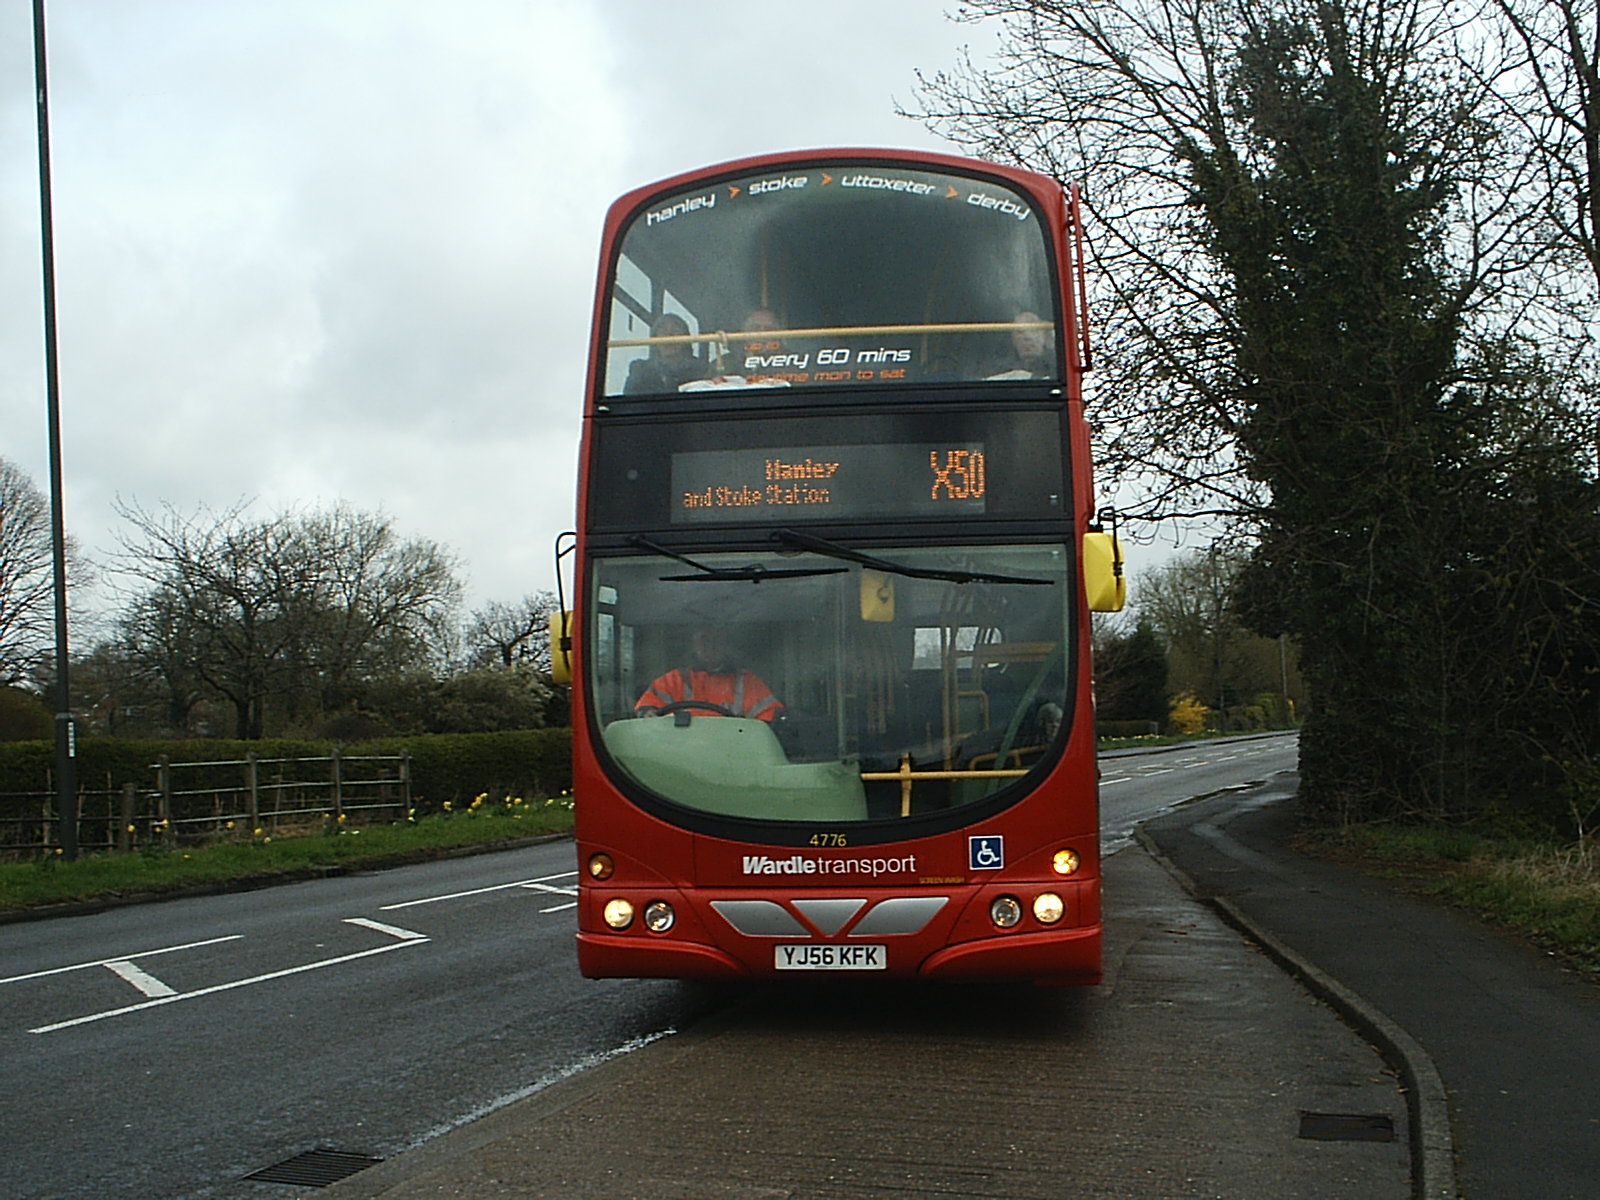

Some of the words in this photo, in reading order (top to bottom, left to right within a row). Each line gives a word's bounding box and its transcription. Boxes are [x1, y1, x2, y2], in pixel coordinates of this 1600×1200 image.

[646, 193, 716, 226] hanley
[749, 176, 808, 195] stoke
[841, 175, 936, 195] uttoxeter
[967, 193, 1031, 221] derby
[744, 353, 809, 368] every
[816, 349, 850, 365] 60
[856, 347, 911, 363] mins
[814, 371, 852, 381] mon
[856, 370, 874, 380] to
[879, 368, 907, 379] sat
[765, 459, 841, 480] Hanley
[929, 450, 986, 500] X50
[683, 487, 713, 508] and
[715, 485, 763, 507] Stoke
[766, 483, 831, 505] Station
[809, 833, 847, 847] 4776
[783, 947, 834, 966] YJ56
[839, 947, 878, 966] KFK
